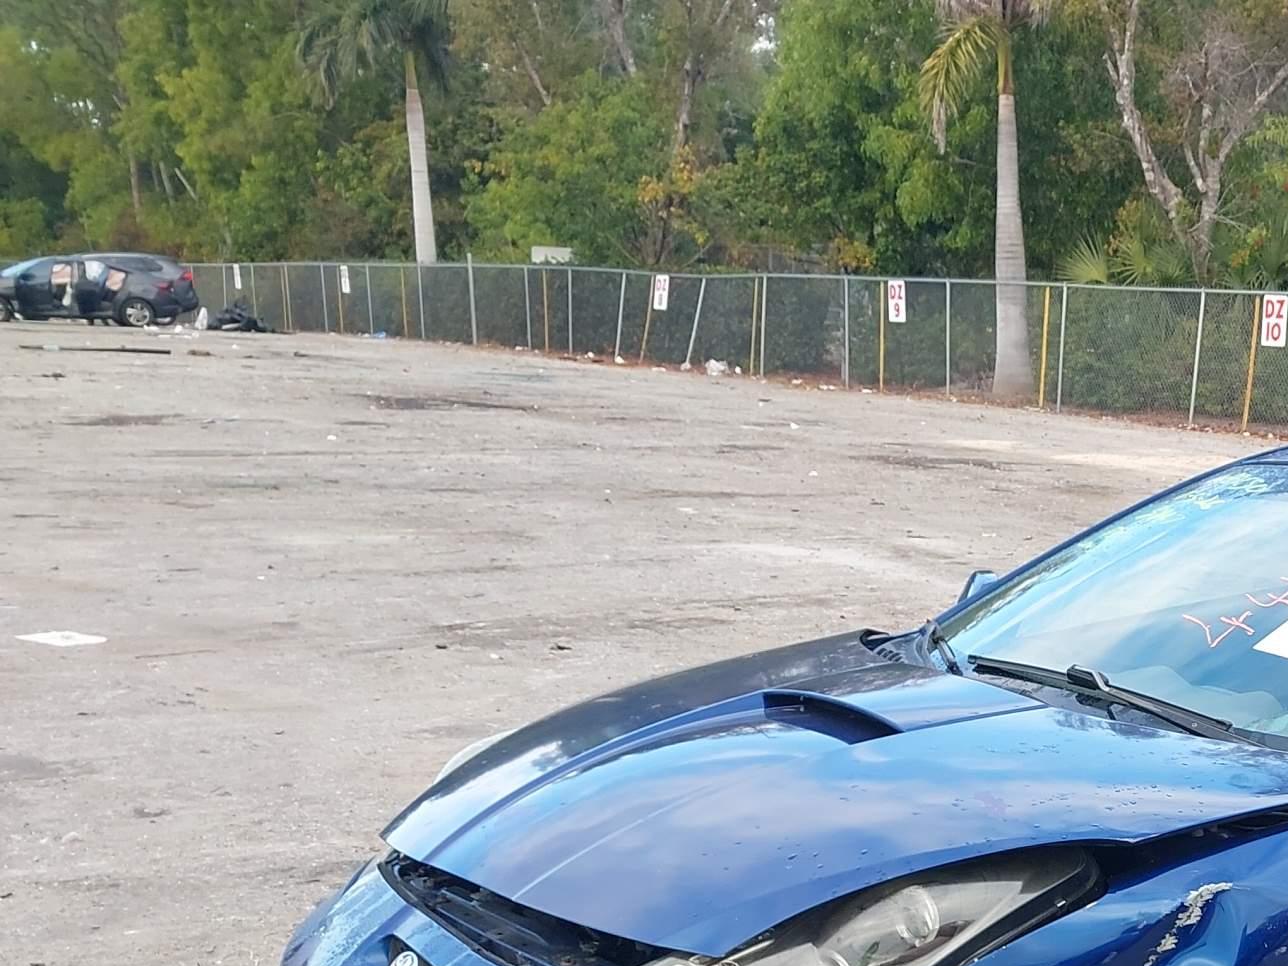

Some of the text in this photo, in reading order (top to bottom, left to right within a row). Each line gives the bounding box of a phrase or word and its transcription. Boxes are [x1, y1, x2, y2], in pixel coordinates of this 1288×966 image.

[889, 284, 903, 300] DZ
[894, 302, 900, 318] 9
[1265, 299, 1286, 319] DZ
[1266, 321, 1282, 341] 10
